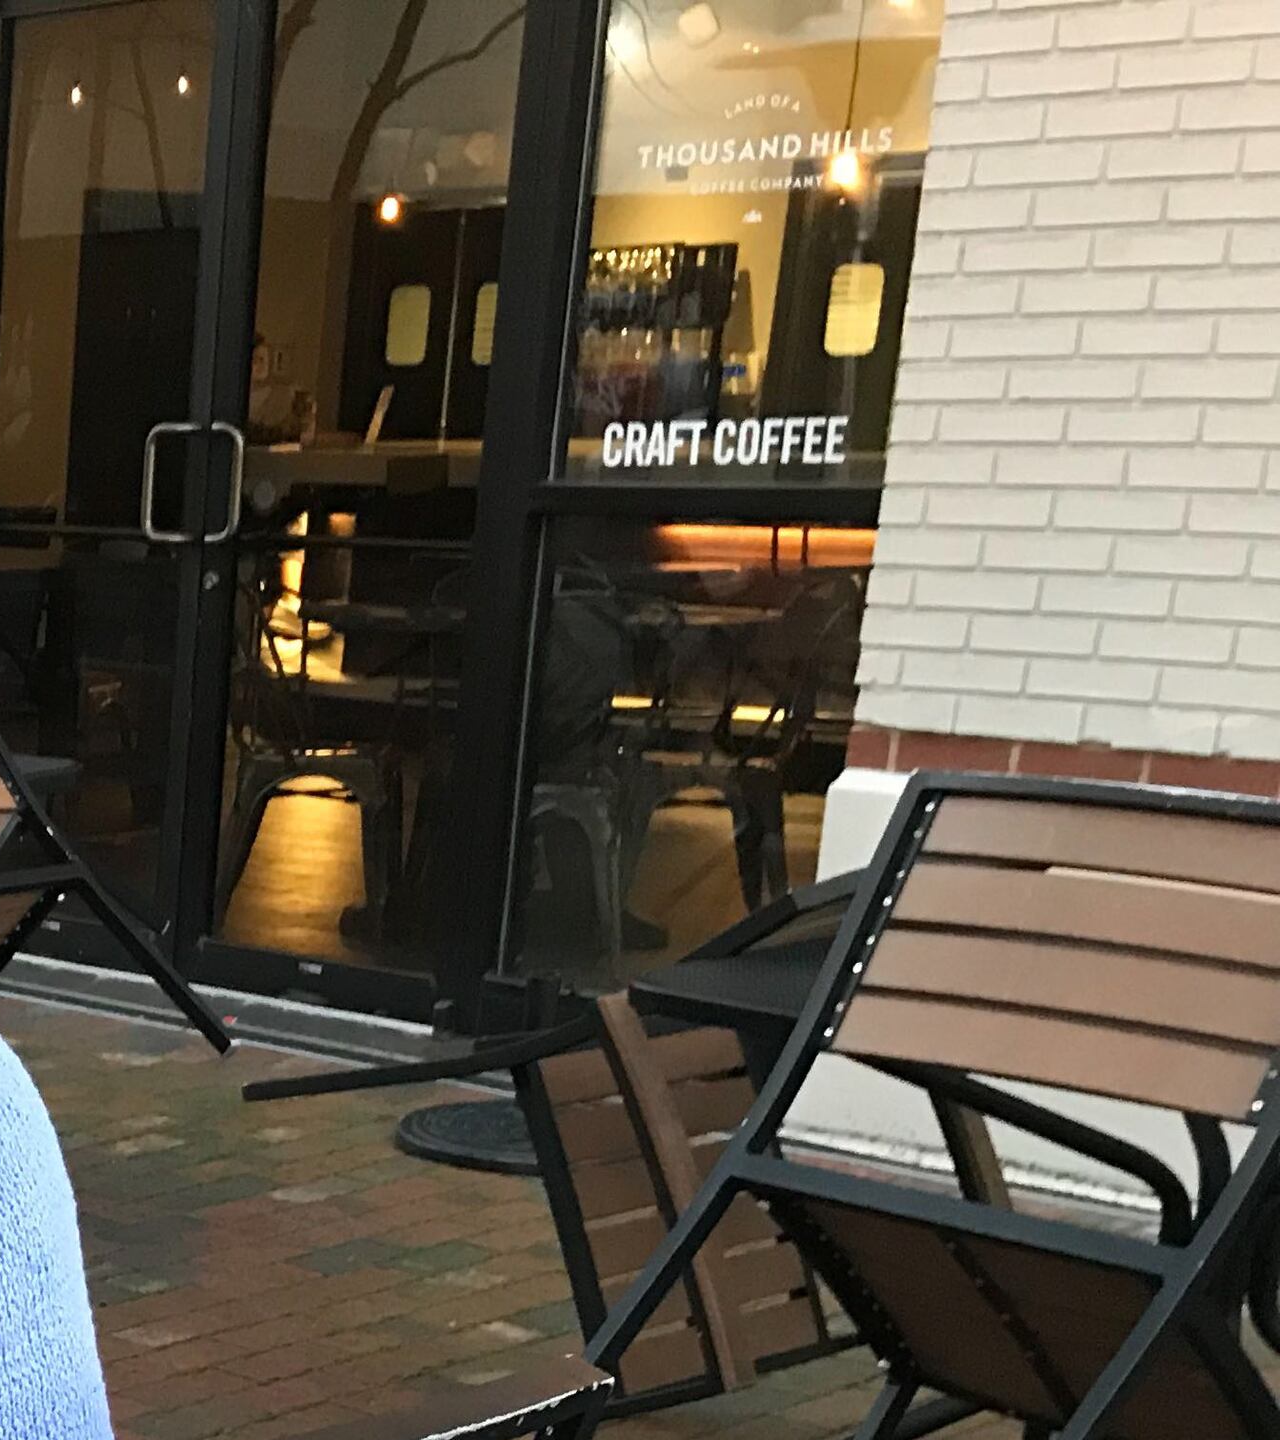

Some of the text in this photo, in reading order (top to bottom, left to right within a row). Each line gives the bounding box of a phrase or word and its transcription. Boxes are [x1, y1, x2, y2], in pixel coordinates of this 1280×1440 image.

[724, 93, 766, 120] LAND
[770, 94, 792, 107] OF
[637, 127, 894, 168] THOUSAND HILLS
[750, 172, 824, 190] COMPANY
[602, 415, 849, 468] CRAFT COFFEE
